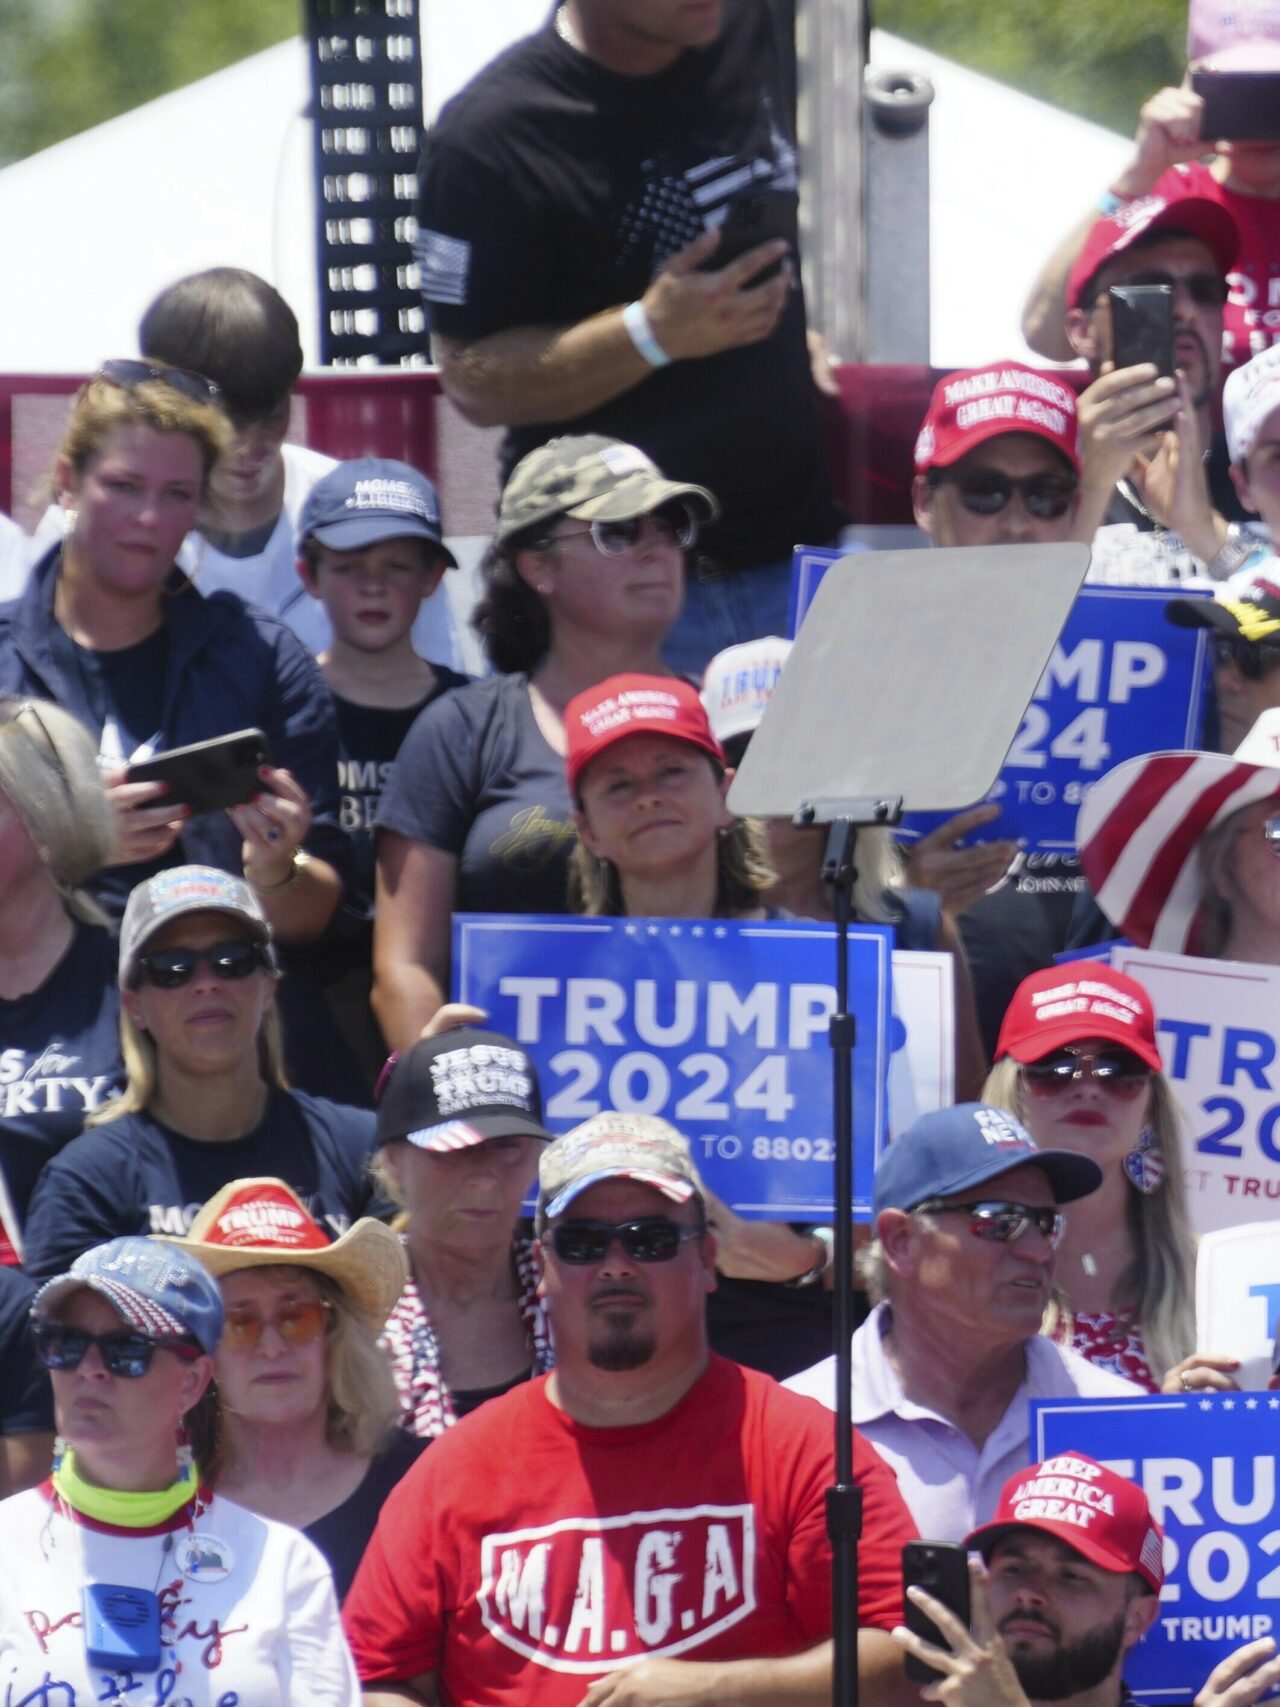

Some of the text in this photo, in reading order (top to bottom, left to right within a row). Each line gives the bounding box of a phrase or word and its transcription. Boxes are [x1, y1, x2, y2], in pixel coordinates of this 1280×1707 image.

[1016, 779, 1056, 805] TO
[500, 975, 839, 1050] TRUMP
[545, 1051, 796, 1122] 2024
[700, 1135, 743, 1160] TO
[217, 1206, 304, 1234] TRUMP
[1036, 1456, 1102, 1482] KEEP
[1009, 1476, 1115, 1517] AMERICA
[1014, 1498, 1096, 1529] GREAT
[1161, 1614, 1273, 1642] TRUMP
